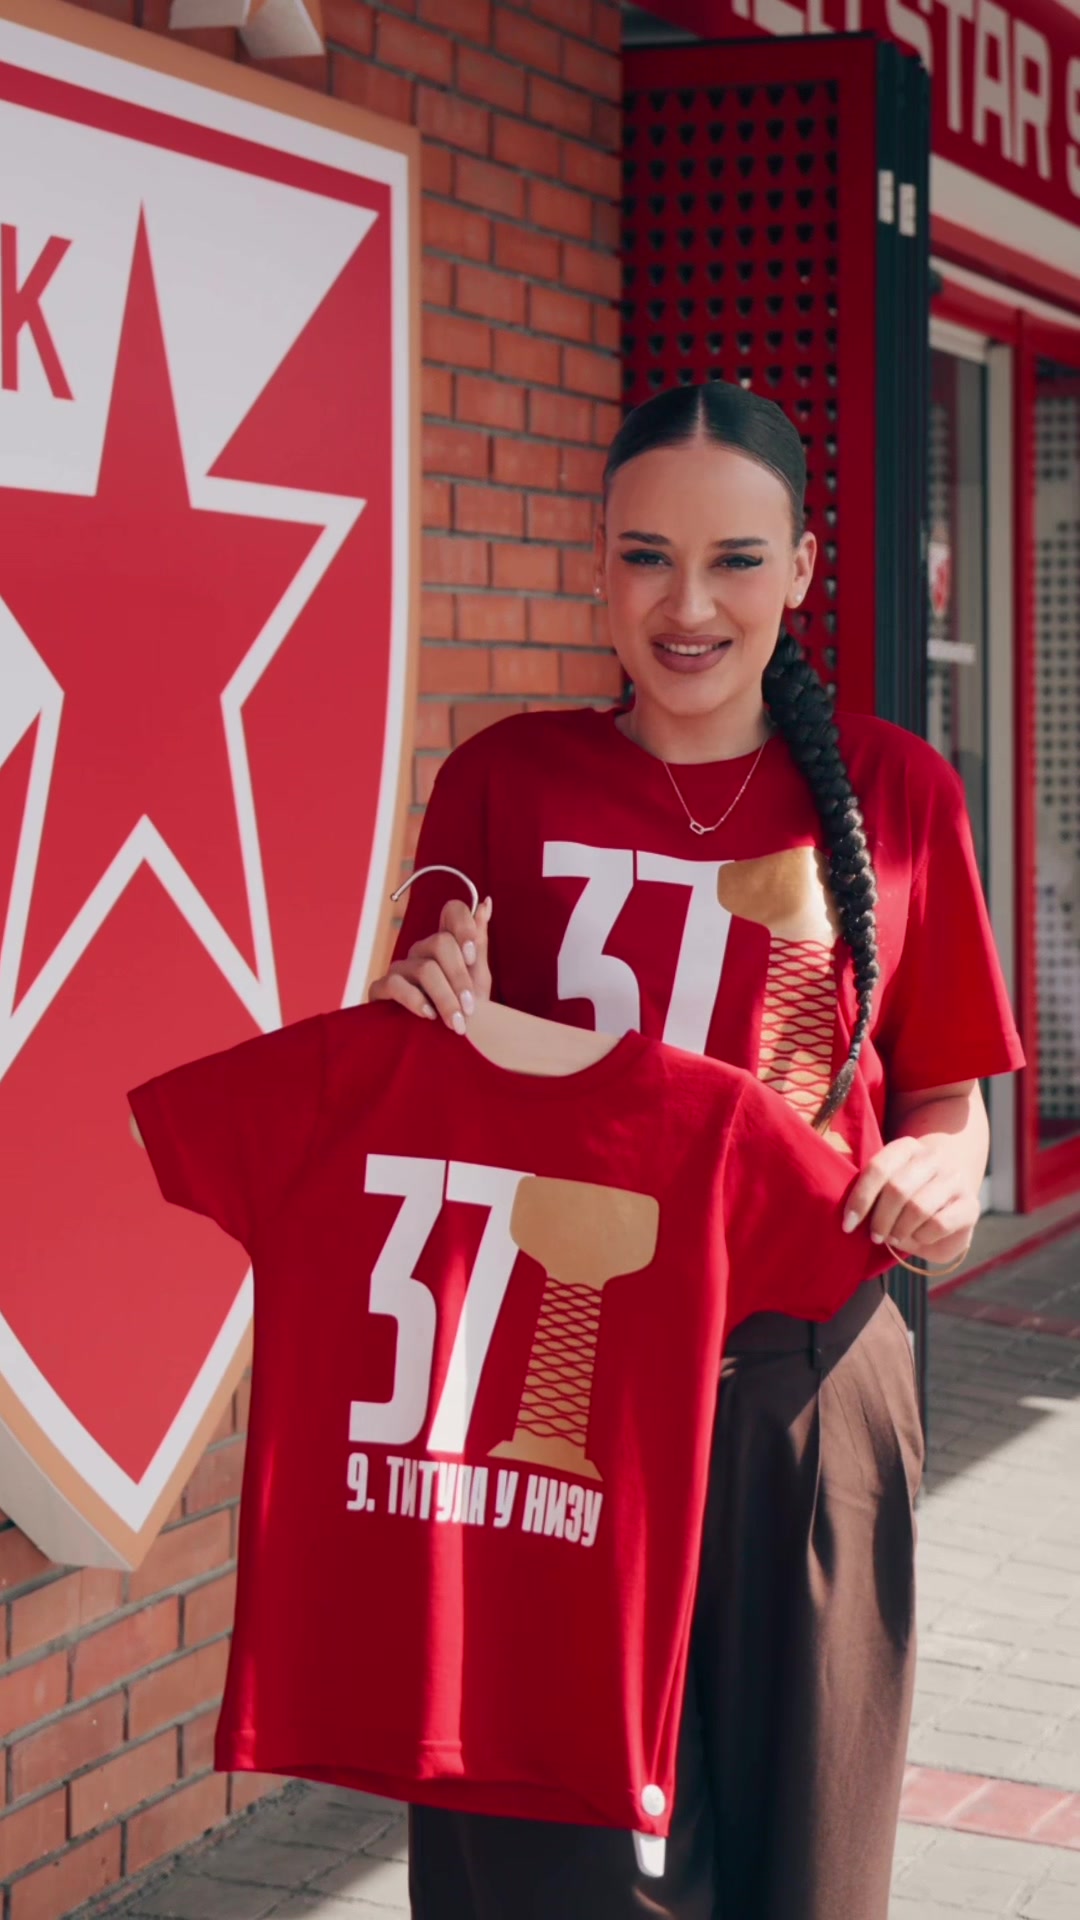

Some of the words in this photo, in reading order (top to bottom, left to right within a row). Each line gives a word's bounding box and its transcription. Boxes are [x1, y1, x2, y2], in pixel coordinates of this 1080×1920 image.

[542, 840, 735, 1056] 37
[348, 1153, 536, 1454] 37
[346, 1451, 376, 1513] 9.
[386, 1455, 489, 1526] ТИТУЛА
[493, 1468, 519, 1529] У
[521, 1473, 604, 1548] НИЗУ
